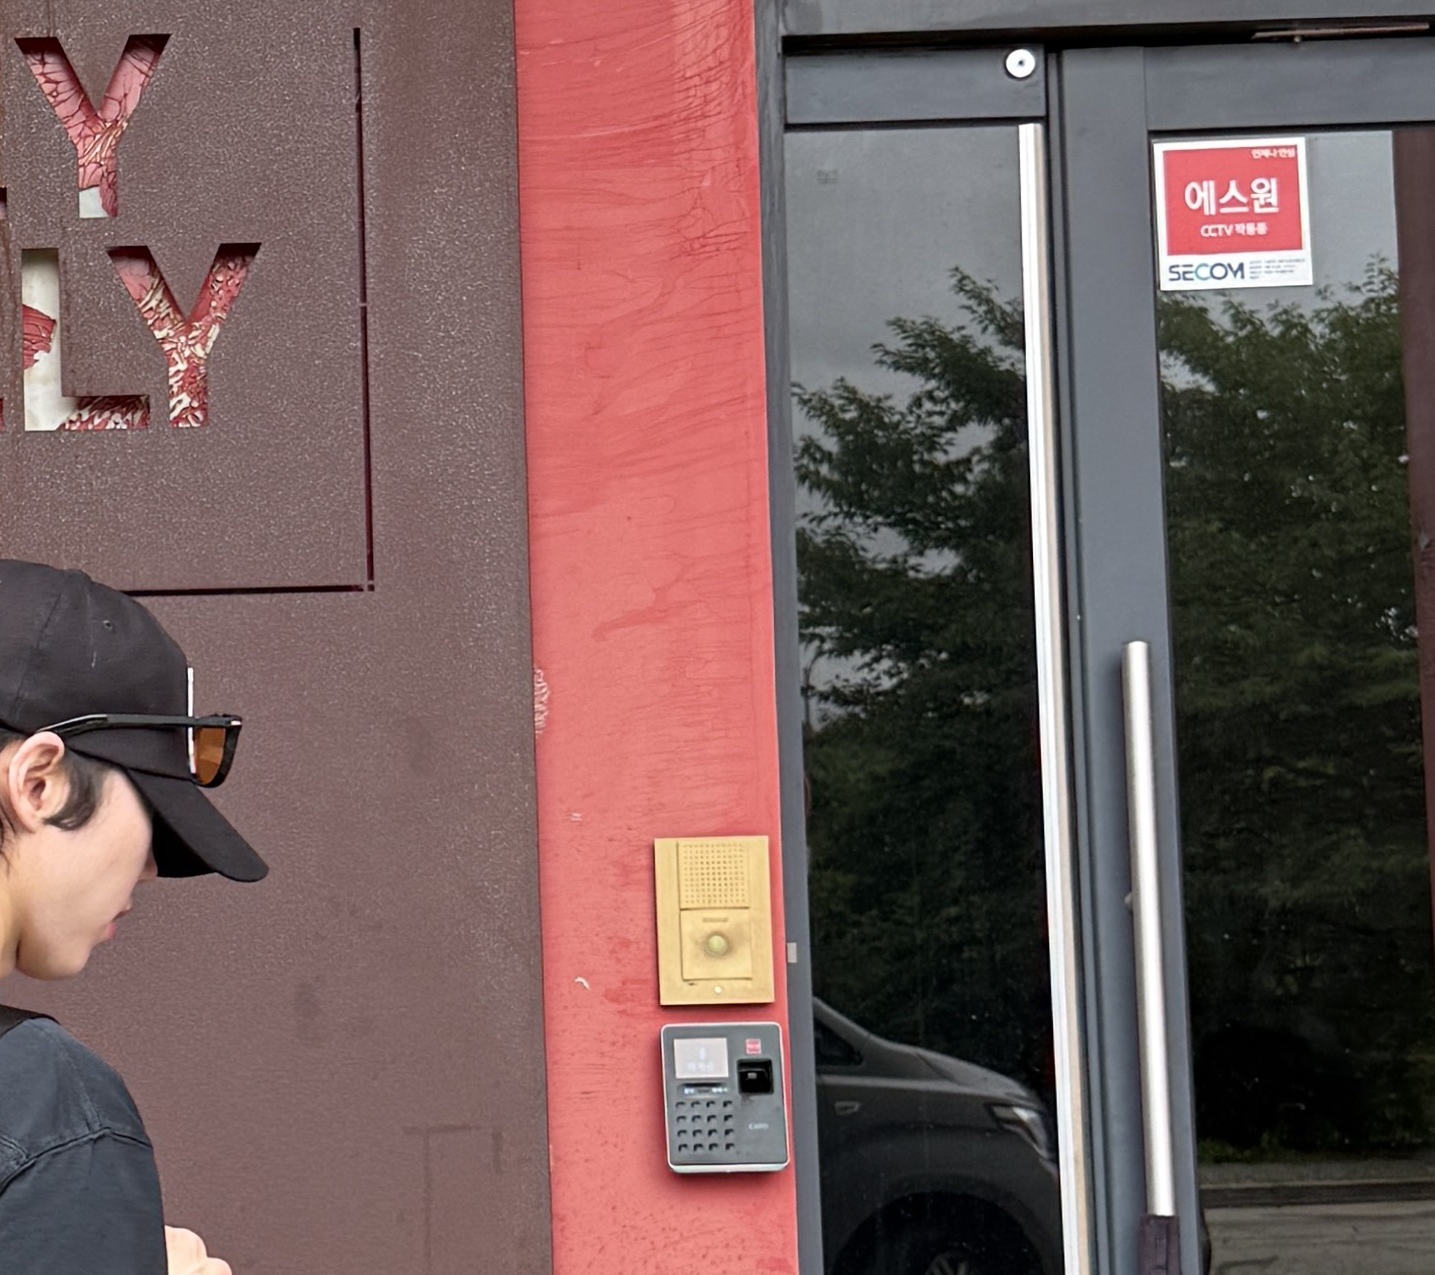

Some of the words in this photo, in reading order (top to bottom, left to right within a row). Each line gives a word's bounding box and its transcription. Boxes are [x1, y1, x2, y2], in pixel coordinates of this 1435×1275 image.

[1184, 177, 1279, 216] 에스원
[1200, 223, 1234, 237] CCTV
[1234, 221, 1268, 236] 작동중
[1168, 262, 1245, 282] SECOM
